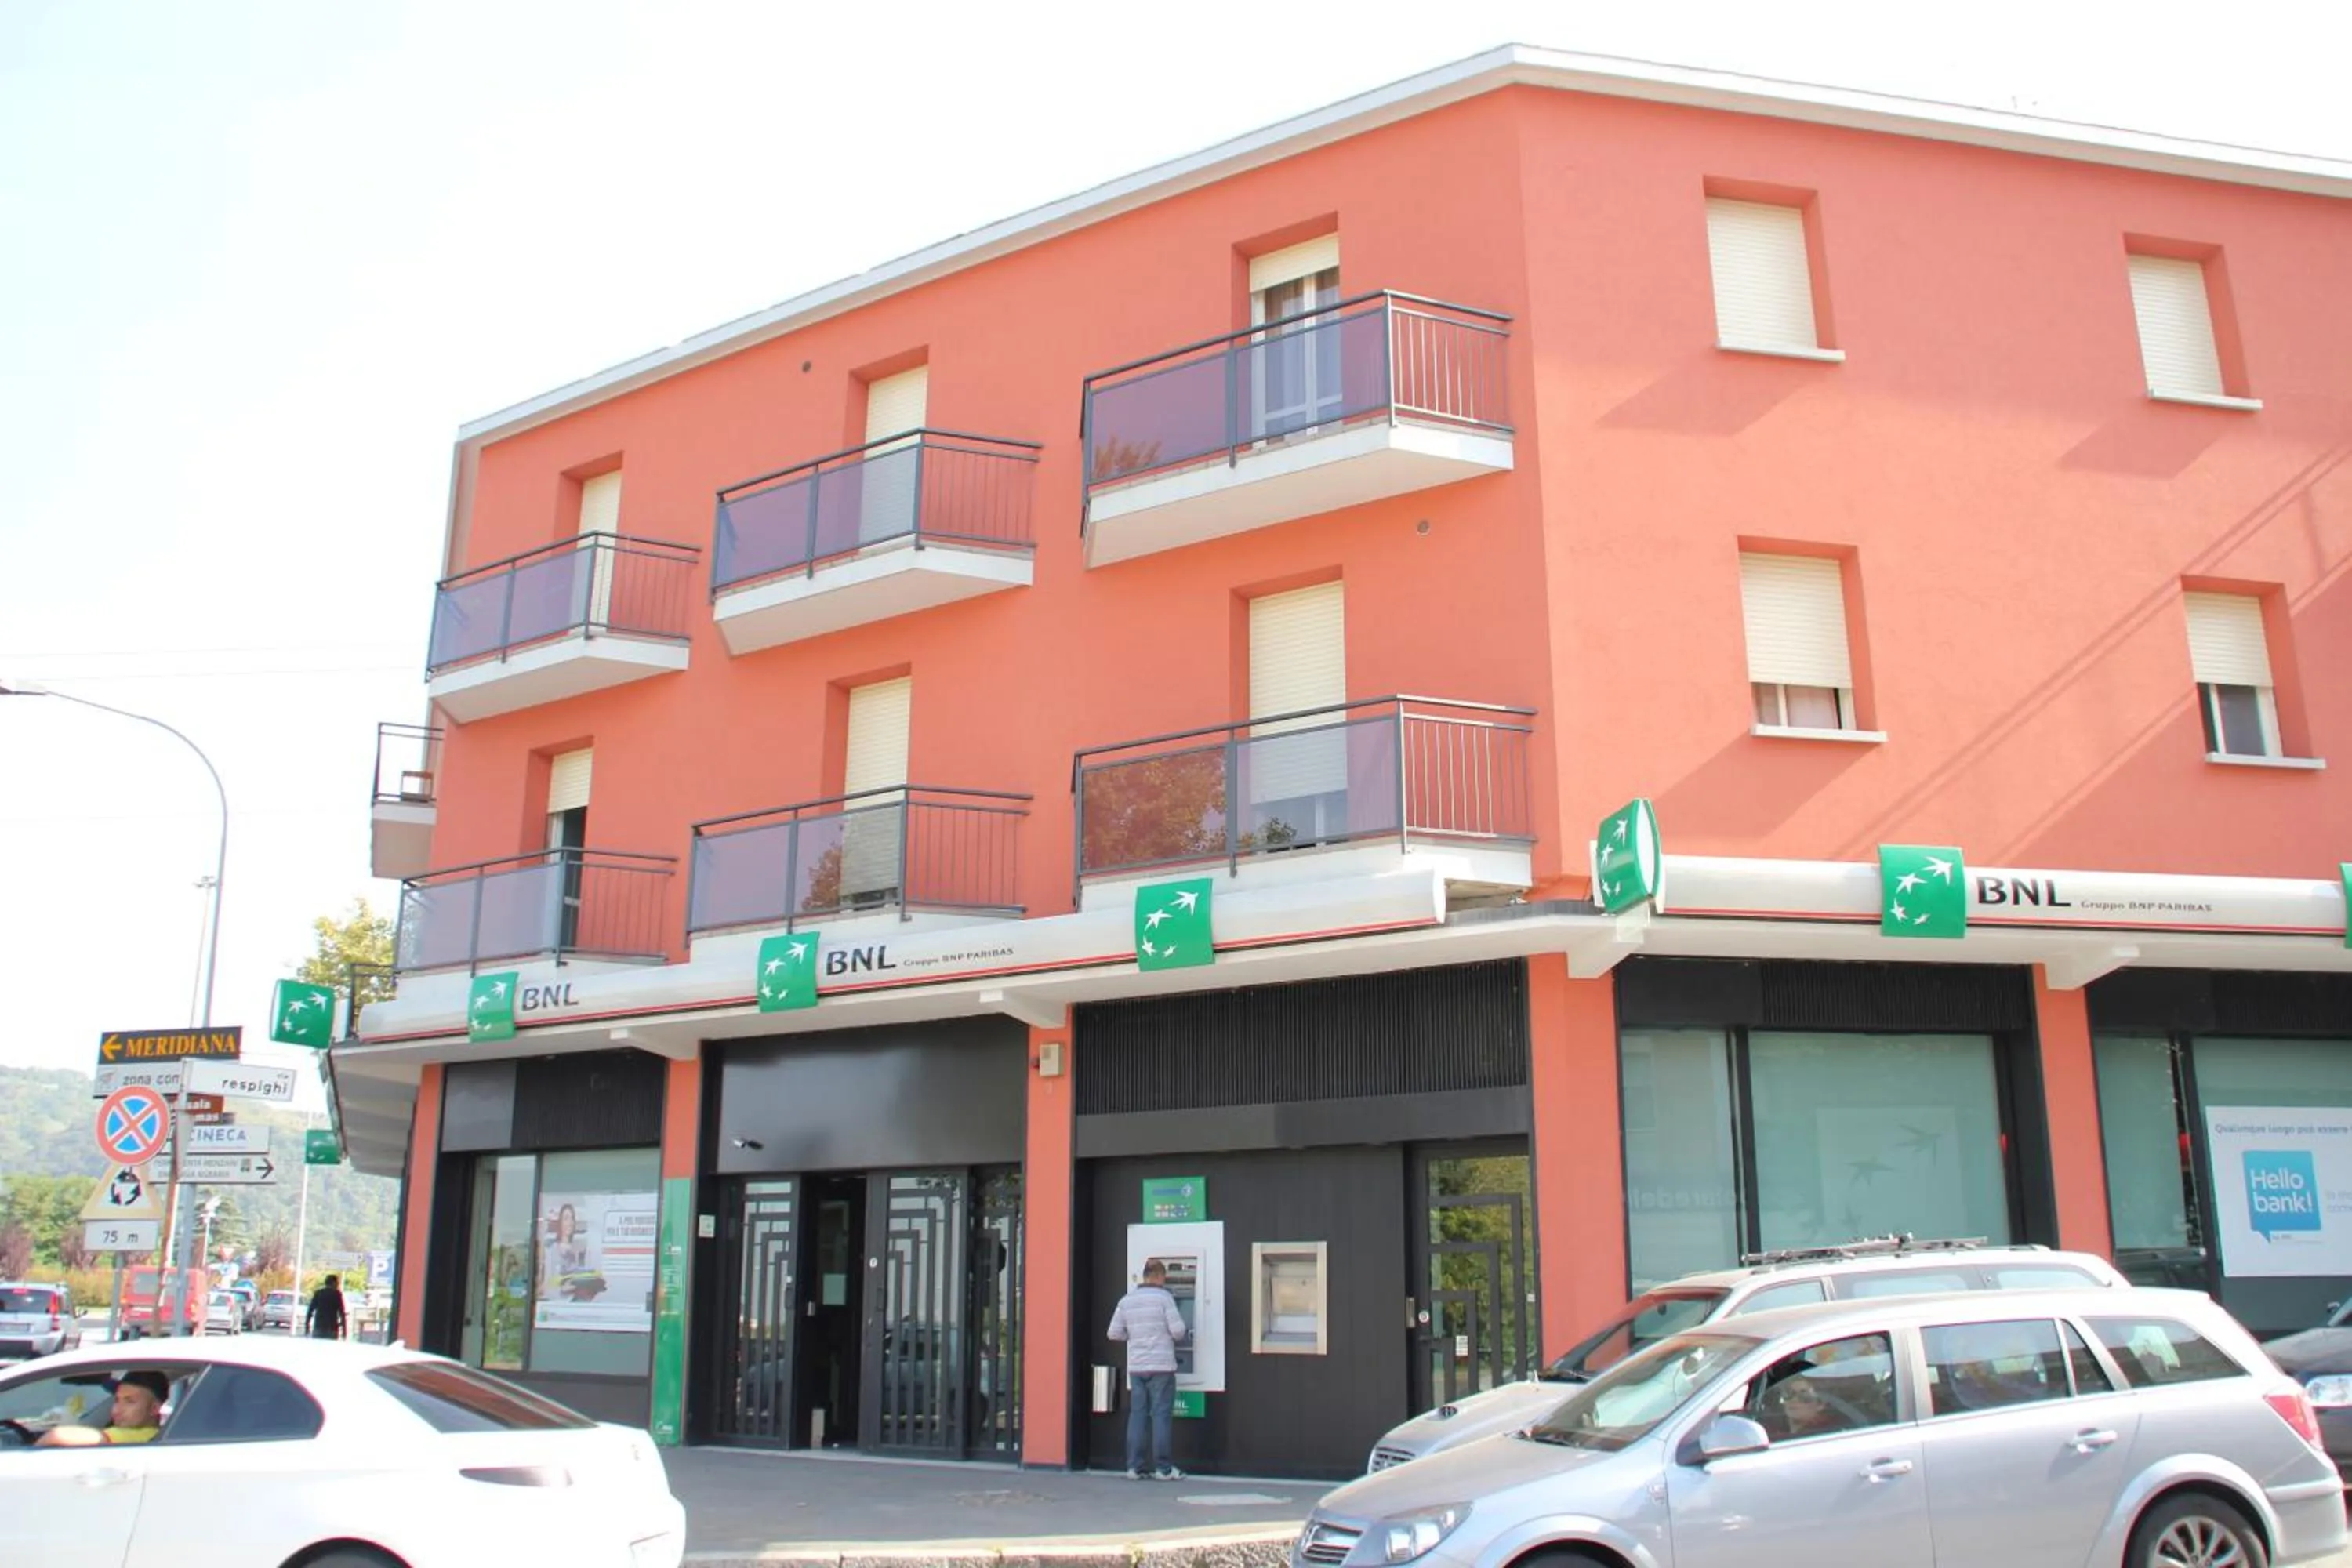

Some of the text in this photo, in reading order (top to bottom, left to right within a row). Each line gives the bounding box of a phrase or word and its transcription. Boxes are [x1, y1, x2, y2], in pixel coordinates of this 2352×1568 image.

[1976, 876, 2213, 912] BNL Gruppo BNP PARIBAS
[826, 945, 1014, 976] BNL Gruppo BNP PARIBAS
[521, 982, 579, 1011] BNL
[125, 1033, 236, 1058] MERIDIANA
[122, 1073, 152, 1086] zona
[221, 1077, 289, 1095] respighi
[188, 1127, 247, 1142] CINECA
[2249, 1167, 2304, 1190] Hello
[2252, 1191, 2313, 1214] bank!
[103, 1230, 139, 1243] 75 m
